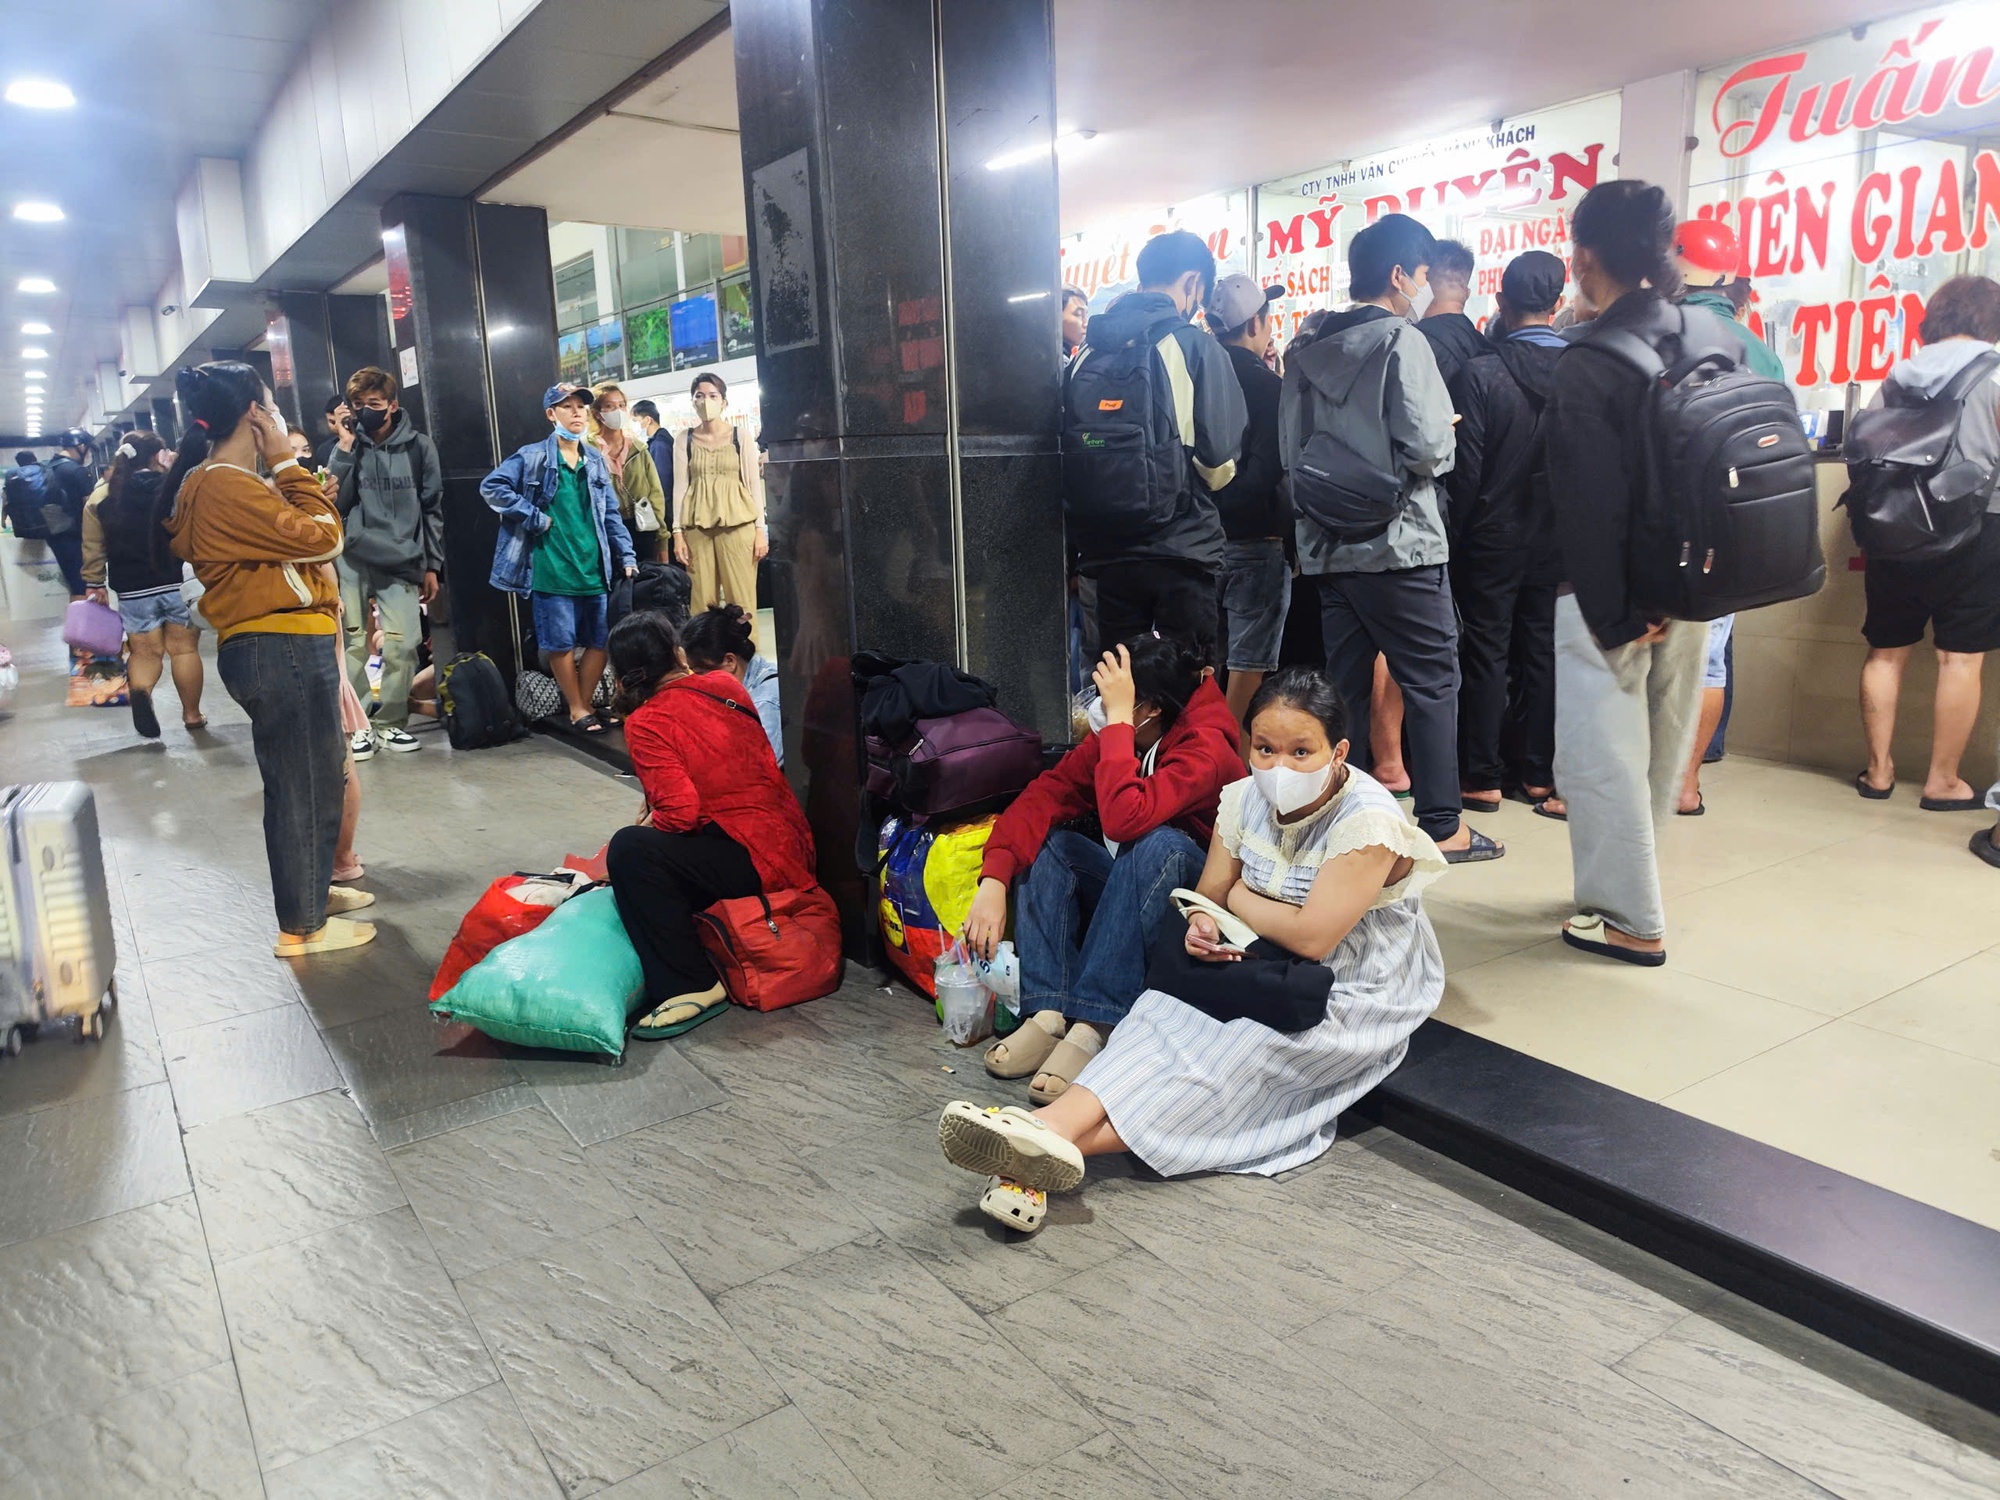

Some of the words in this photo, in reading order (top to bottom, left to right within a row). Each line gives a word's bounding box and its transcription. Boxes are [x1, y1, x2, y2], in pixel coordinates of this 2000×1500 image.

[1301, 178, 1323, 197] CTY
[1326, 171, 1356, 191] TNHH
[1360, 161, 1384, 182] VẬN
[1266, 193, 1344, 260] MỸ
[1480, 222, 1517, 260] ĐẠI
[1698, 170, 1837, 279] IÊN
[1287, 261, 1331, 299] SÁCH
